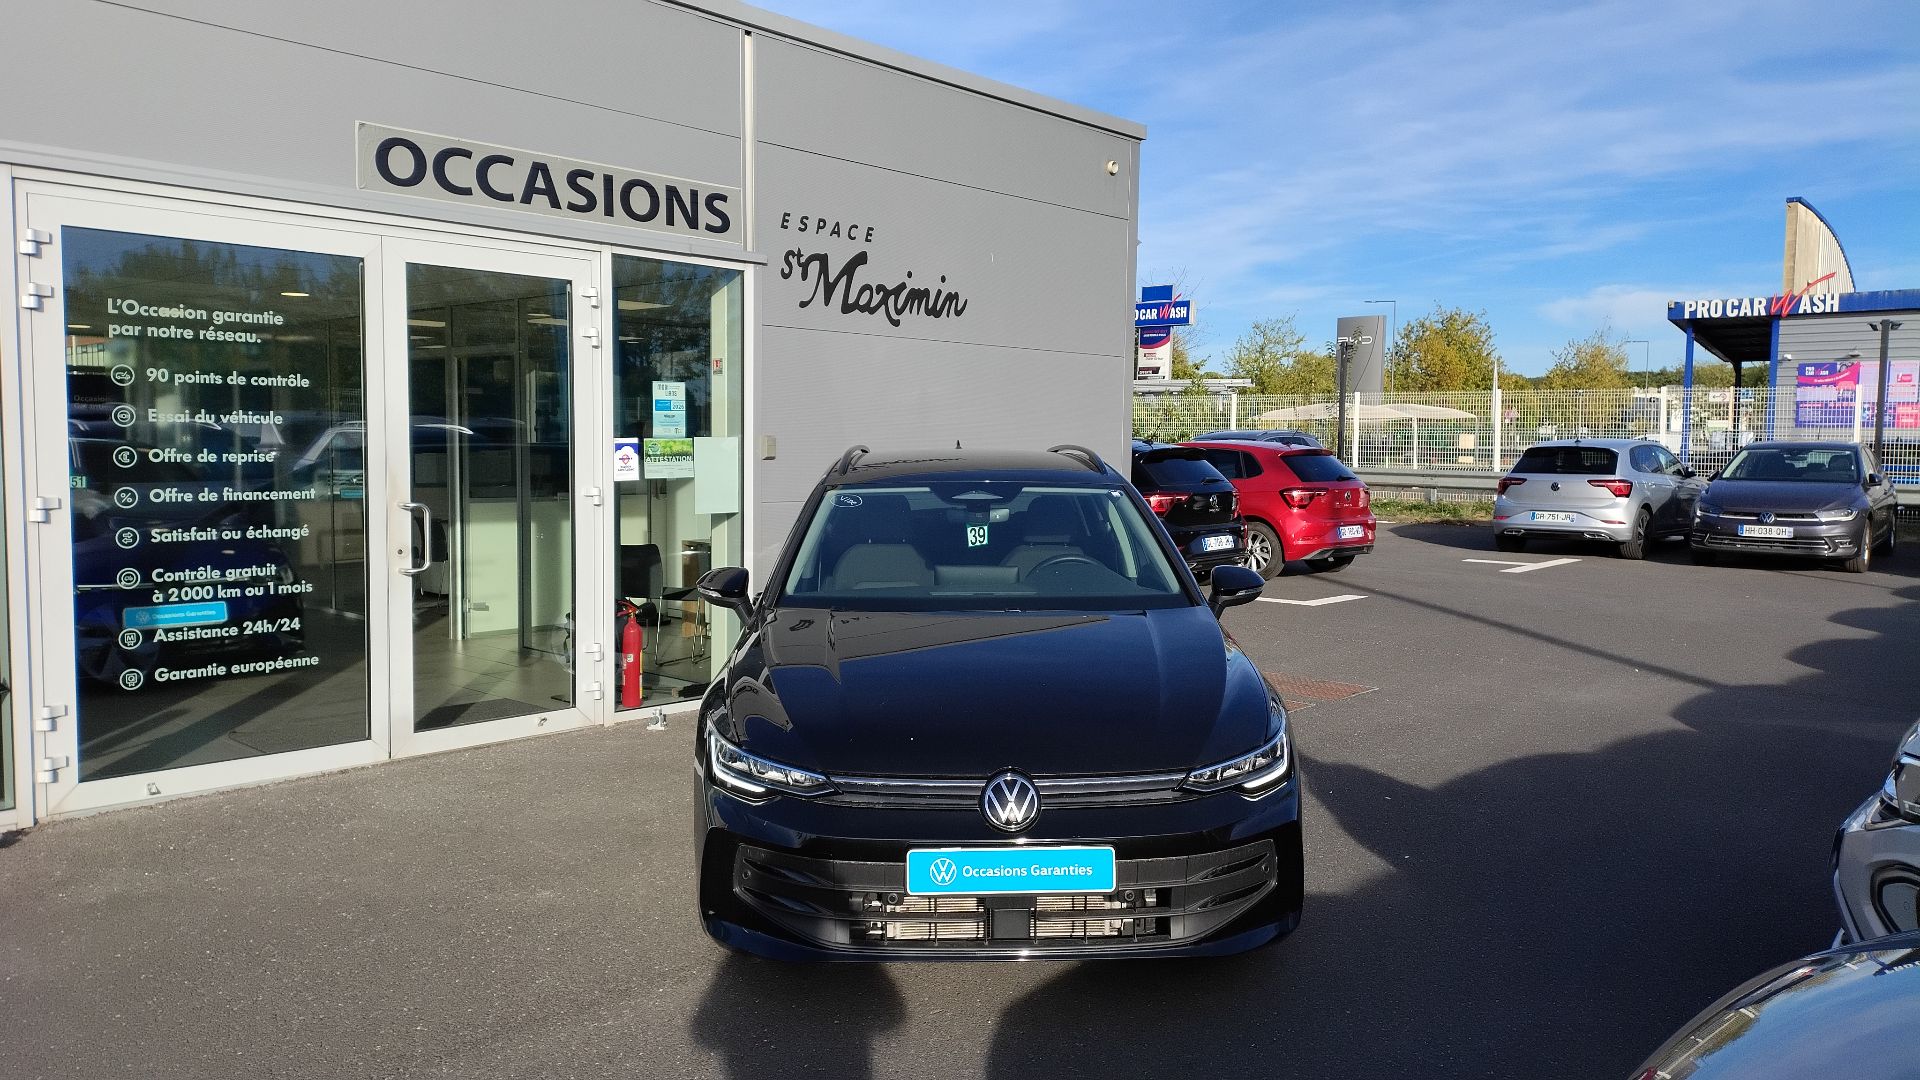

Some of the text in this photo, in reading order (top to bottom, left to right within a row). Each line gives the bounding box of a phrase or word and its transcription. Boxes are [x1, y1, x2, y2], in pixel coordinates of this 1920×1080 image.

[375, 136, 731, 235] OCCASIONS
[780, 212, 875, 242] ESPACE
[780, 246, 968, 327] St Maximin
[1684, 272, 1840, 319] PRO CAR WASH
[1139, 308, 1158, 320] CAR
[1159, 293, 1188, 319] WASH
[212, 309, 284, 326] garantie
[108, 323, 262, 344] par notre réseau.
[146, 368, 310, 388] 90 points de contrôle
[147, 408, 284, 425] Essai du véhicule
[148, 448, 275, 467] Offre de reprise
[149, 487, 316, 503] Offre de financement
[150, 523, 310, 544] Satisfait ou échangé
[969, 526, 986, 546] 39
[151, 563, 277, 584] Contrôle gratuit
[152, 591, 164, 604] à
[217, 584, 241, 600] km
[245, 585, 265, 597] ou
[267, 581, 276, 596] 1
[278, 580, 314, 594] mois
[153, 617, 302, 643] Assistance 24h/24
[154, 653, 320, 682] Garantie européenne
[962, 865, 1028, 878] Occasions
[1030, 864, 1093, 877] Garanties
